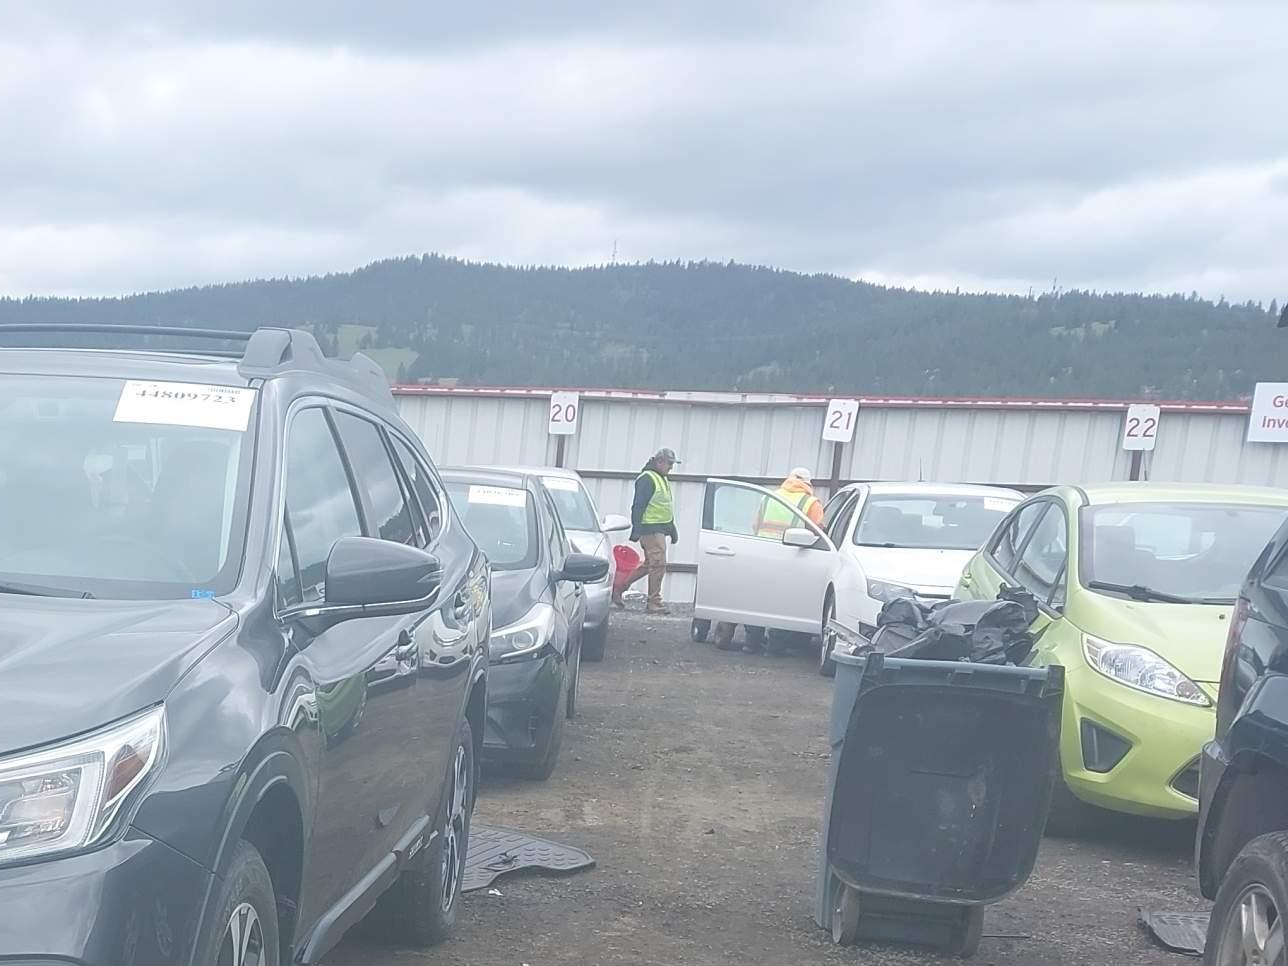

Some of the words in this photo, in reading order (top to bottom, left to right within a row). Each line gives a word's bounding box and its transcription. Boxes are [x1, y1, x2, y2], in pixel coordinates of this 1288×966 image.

[135, 389, 237, 404] 44809723
[551, 403, 576, 423] 20
[829, 410, 852, 430] 21
[1126, 417, 1156, 437] 22
